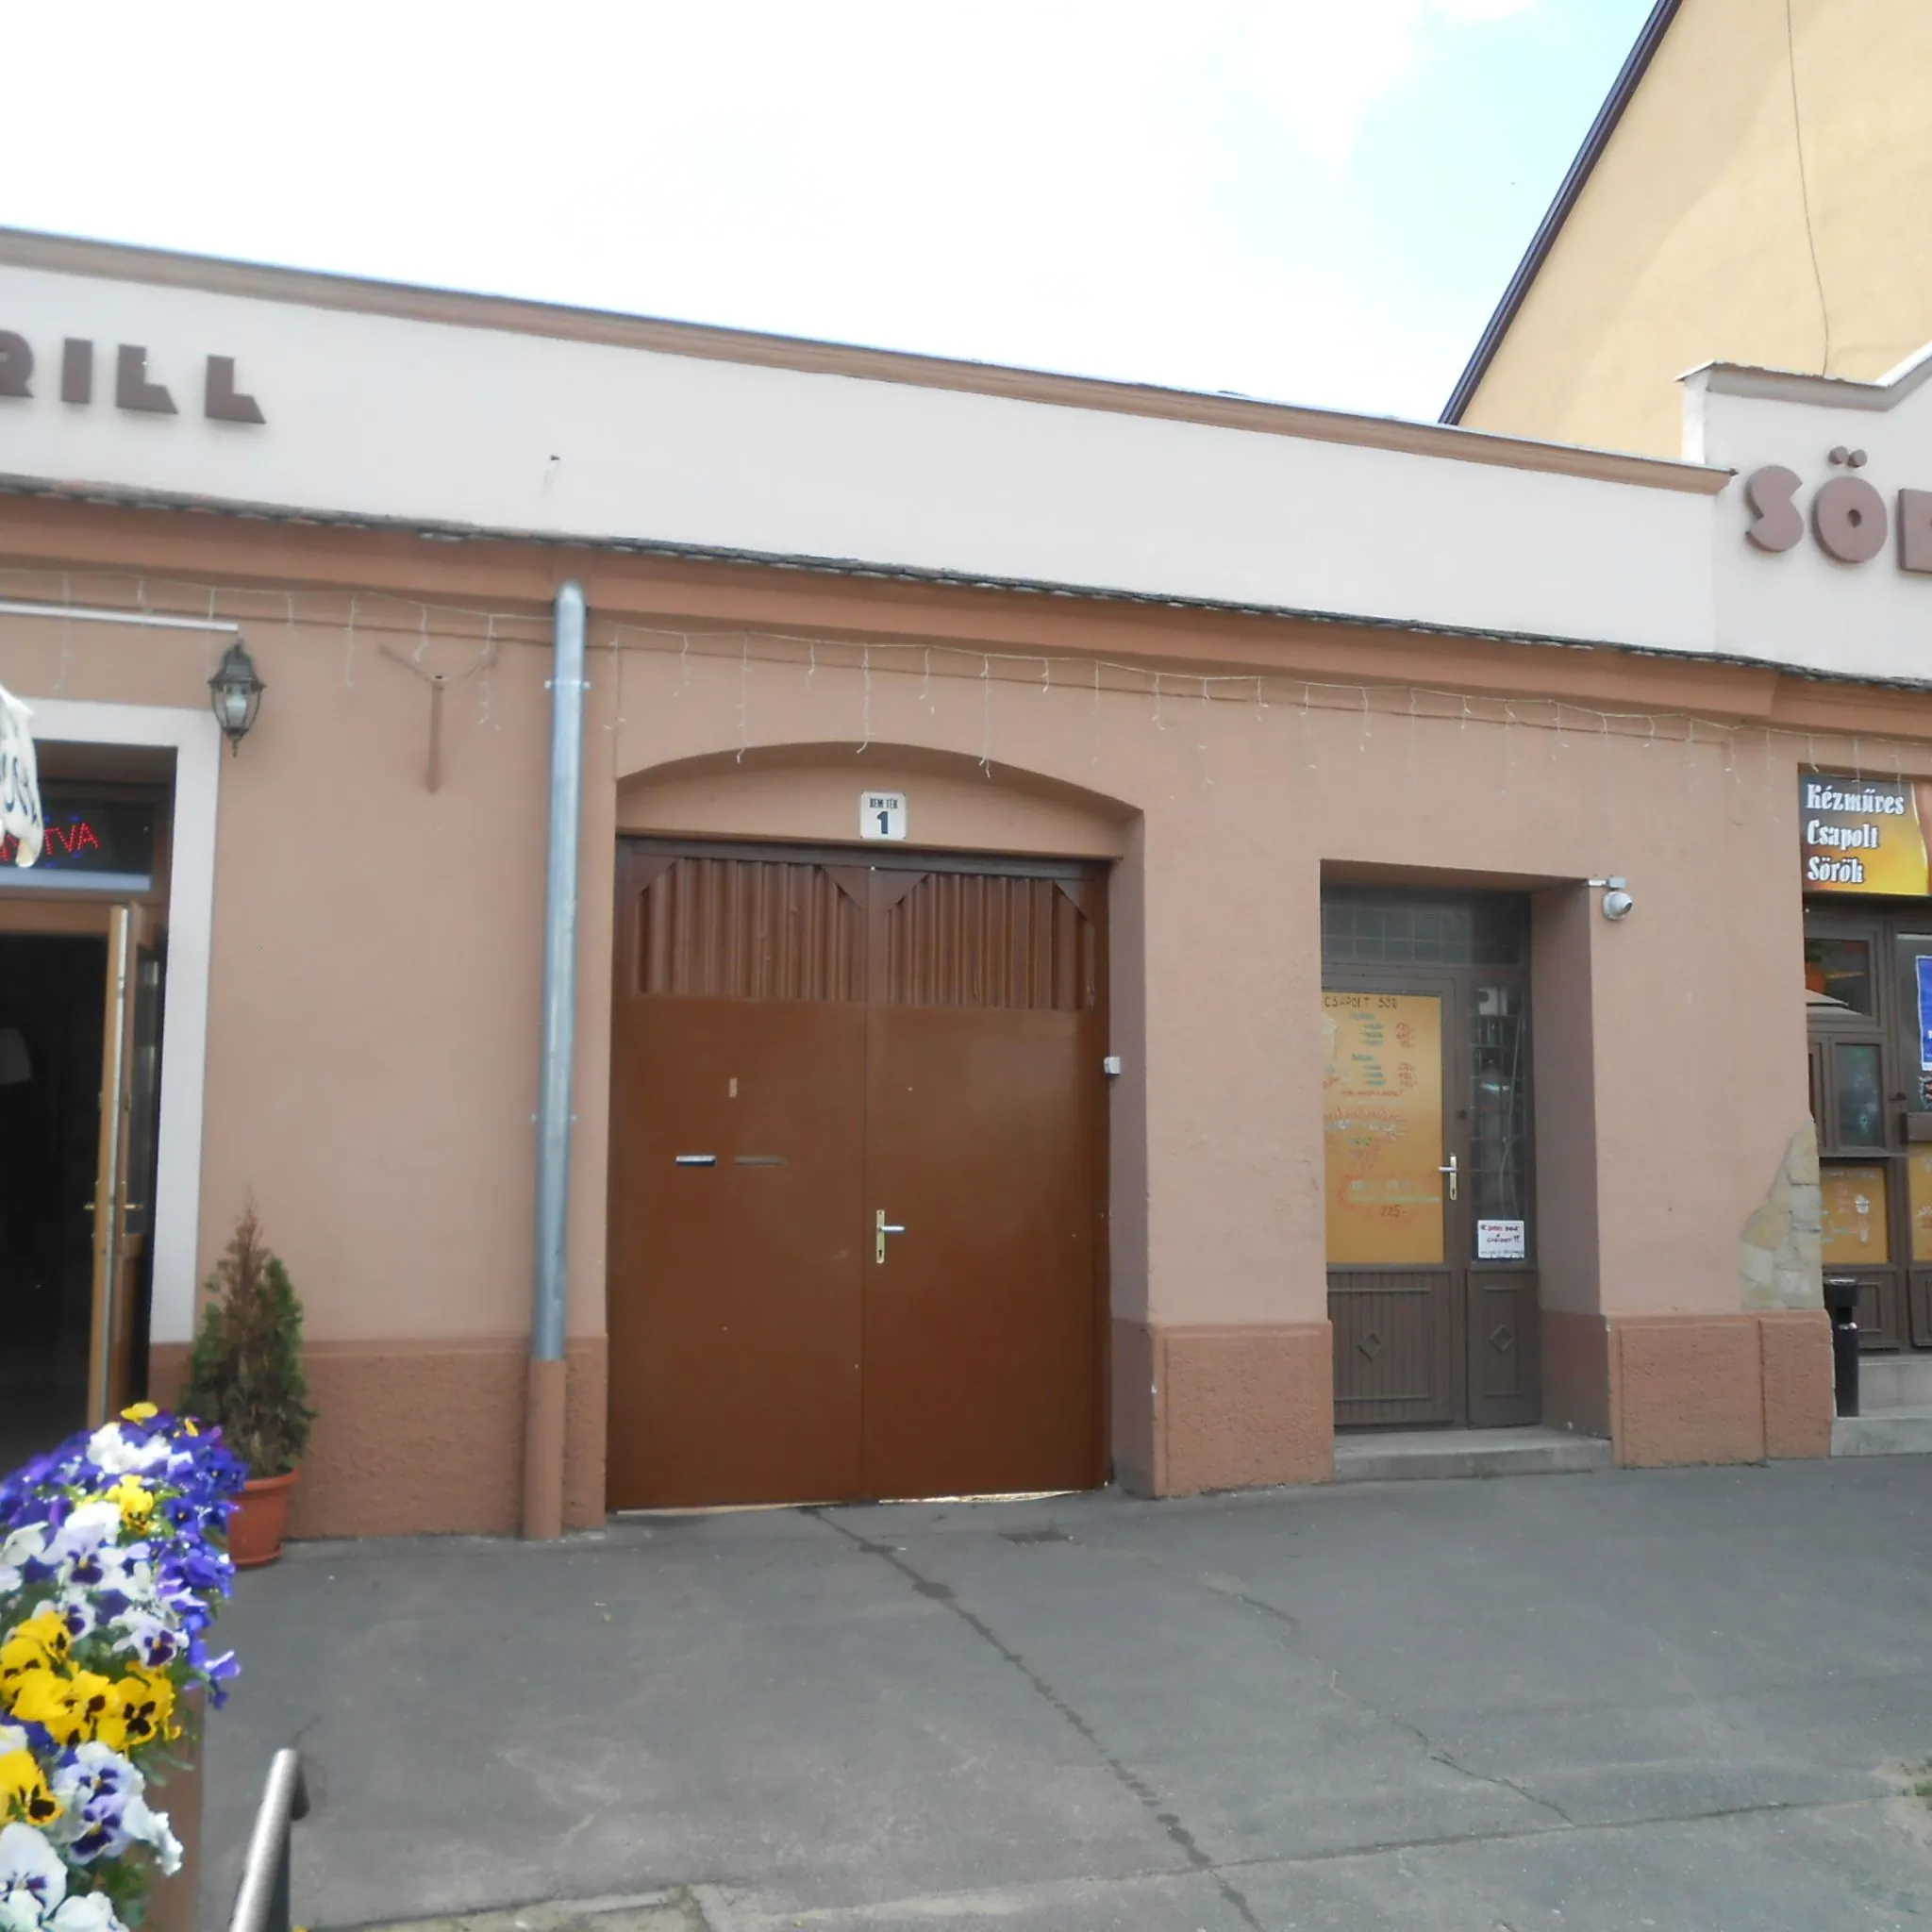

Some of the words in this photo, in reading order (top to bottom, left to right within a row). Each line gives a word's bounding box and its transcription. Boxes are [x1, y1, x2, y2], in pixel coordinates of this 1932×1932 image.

[1806, 783, 1906, 815] Kézműves
[876, 810, 889, 835] 1
[1807, 819, 1879, 851] Csapolt
[1807, 856, 1865, 883] Sörök
